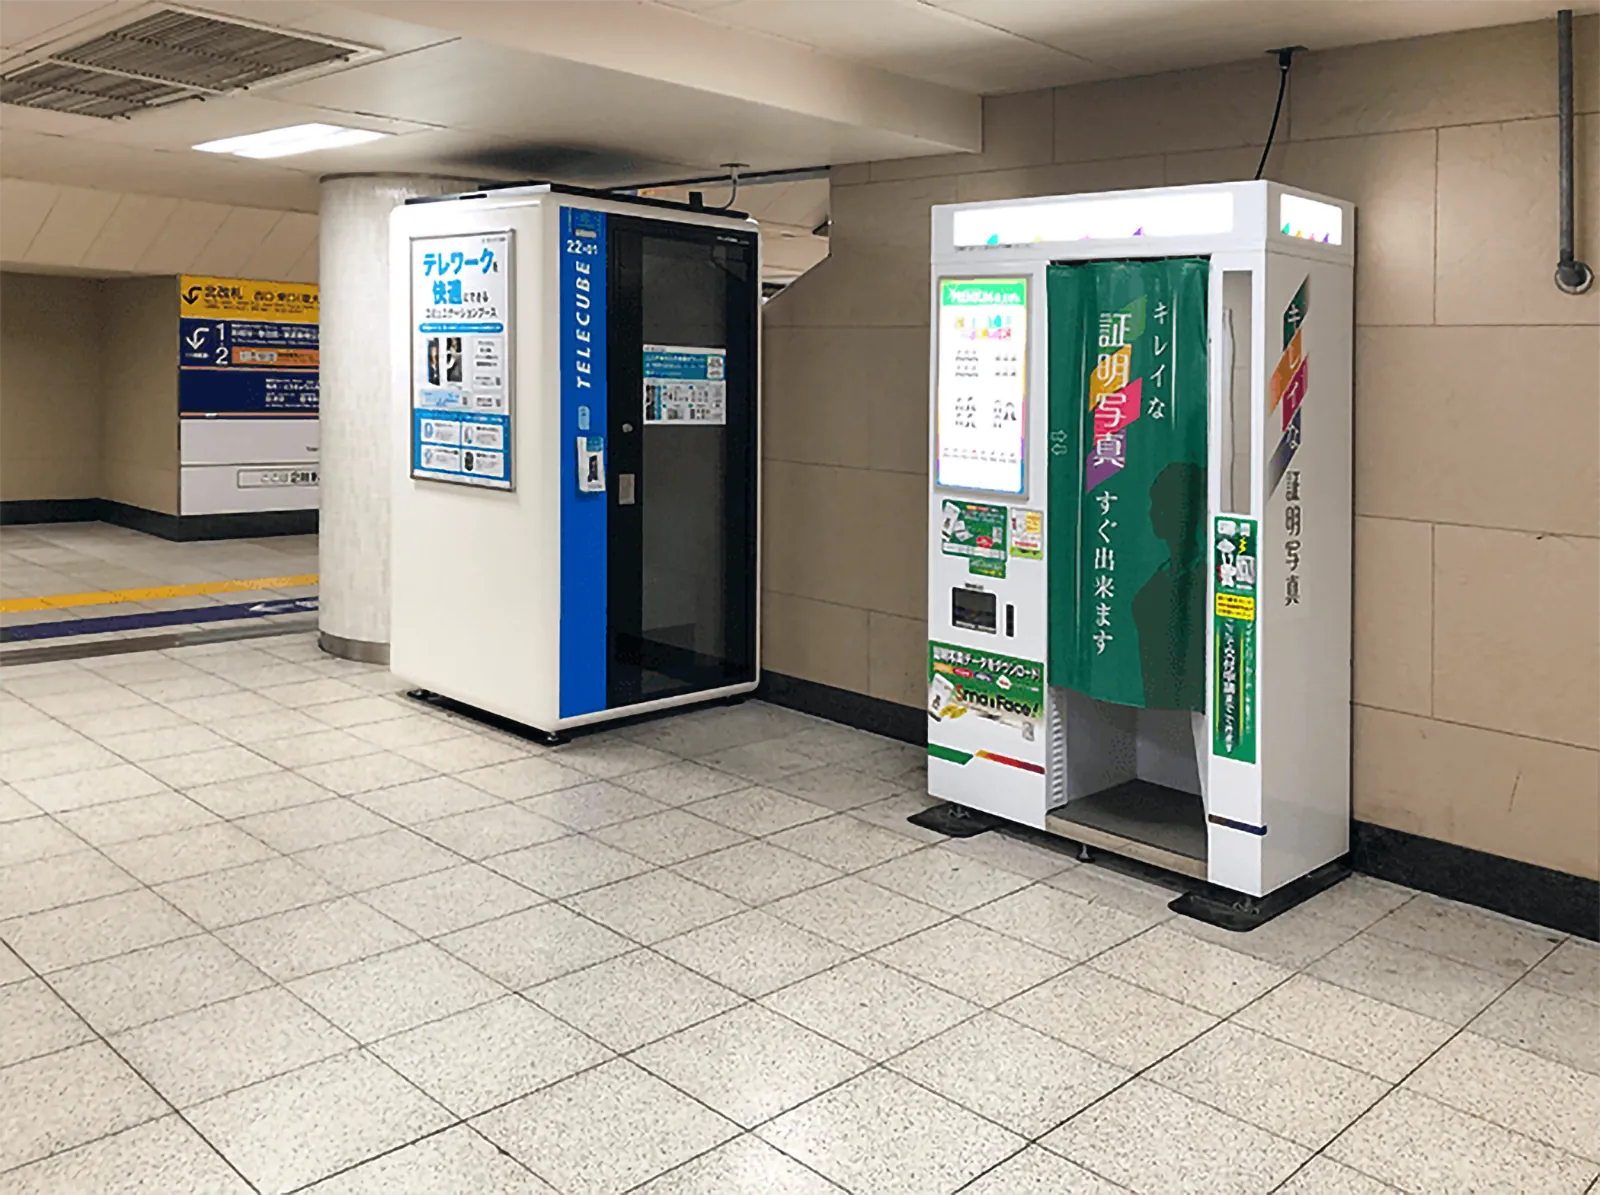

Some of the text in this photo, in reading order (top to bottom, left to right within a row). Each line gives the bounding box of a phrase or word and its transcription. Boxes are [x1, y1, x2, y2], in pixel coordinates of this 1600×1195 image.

[215, 346, 229, 365] 2
[216, 322, 225, 341] 1
[575, 260, 591, 388] TELECUBE
[1148, 301, 1168, 419] キレイな
[1285, 303, 1301, 450] キレイな
[1093, 312, 1133, 469] 証明写真
[1093, 490, 1119, 656] すぐ出来ます
[1285, 470, 1302, 607] 証明写真
